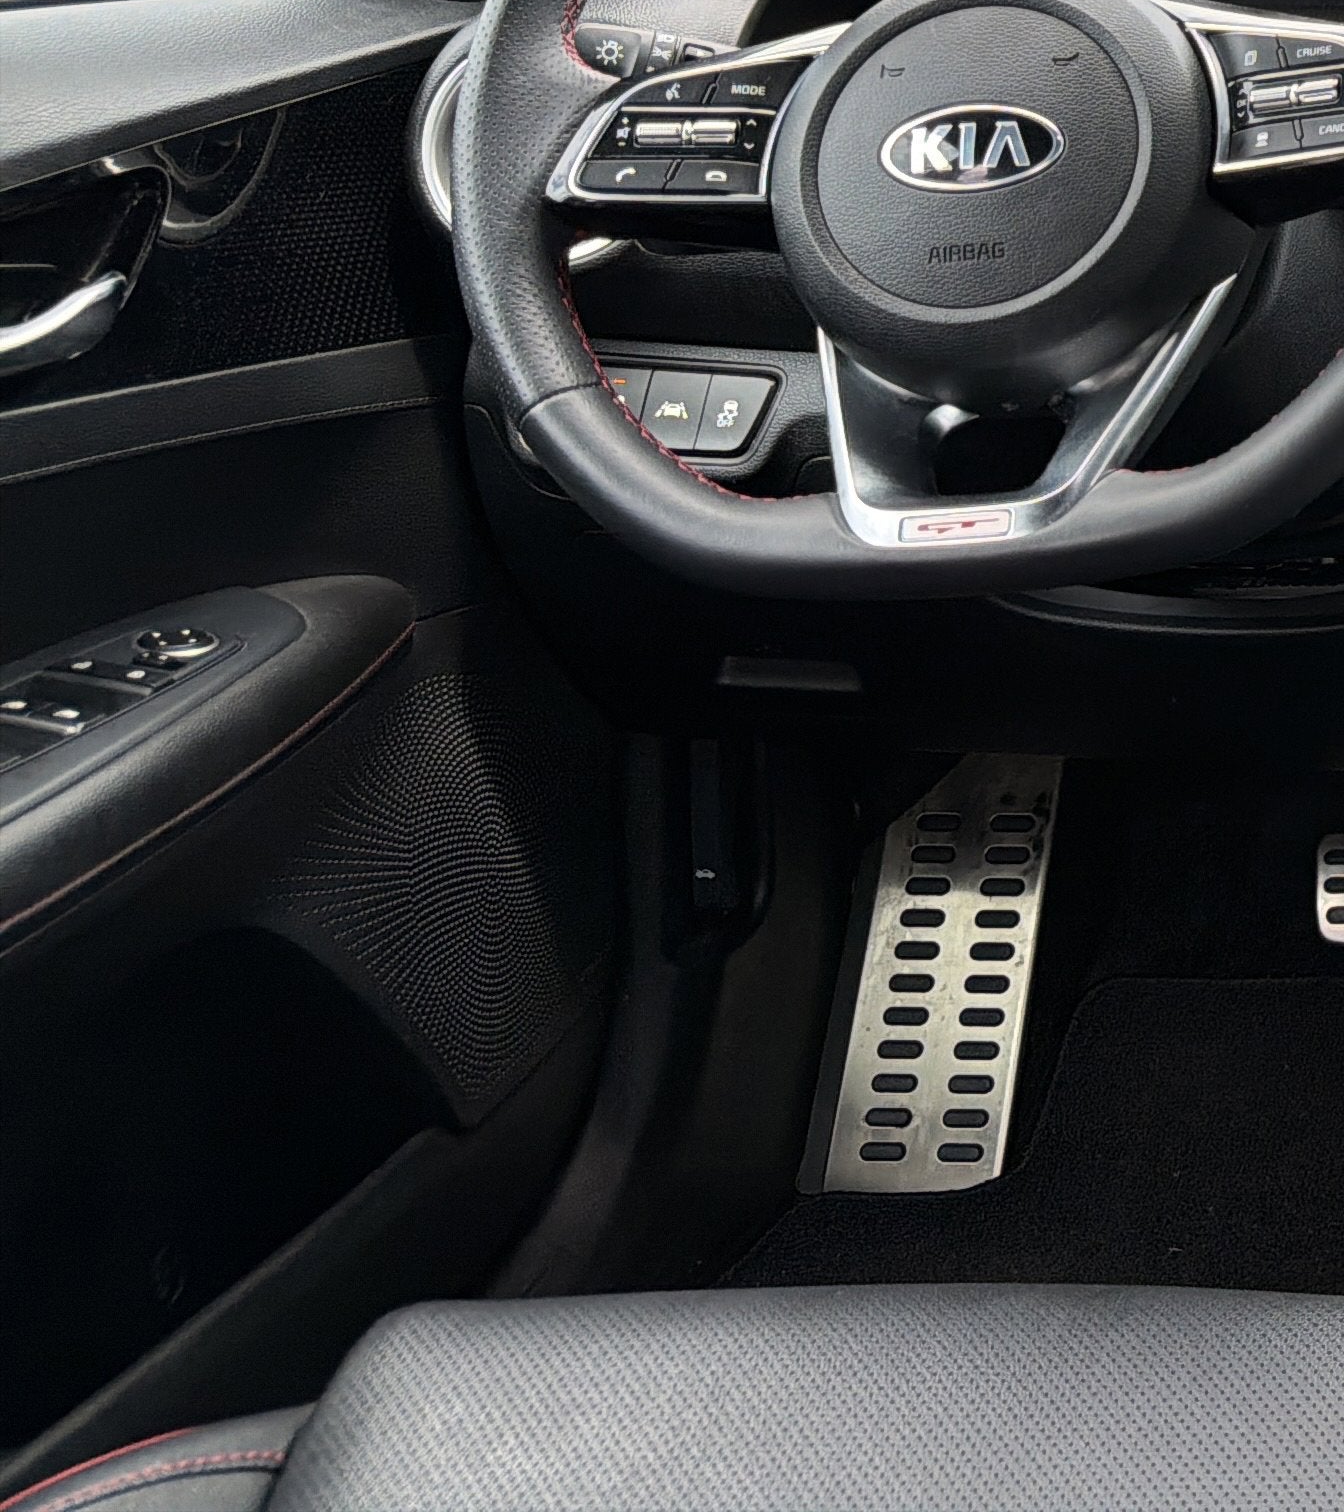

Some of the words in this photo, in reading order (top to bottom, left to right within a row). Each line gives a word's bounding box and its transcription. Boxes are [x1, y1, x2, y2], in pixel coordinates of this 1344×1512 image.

[1296, 45, 1333, 59] CRUISE
[731, 84, 767, 96] MODE
[910, 120, 1031, 175] KIA
[928, 242, 1006, 265] AIRBAG
